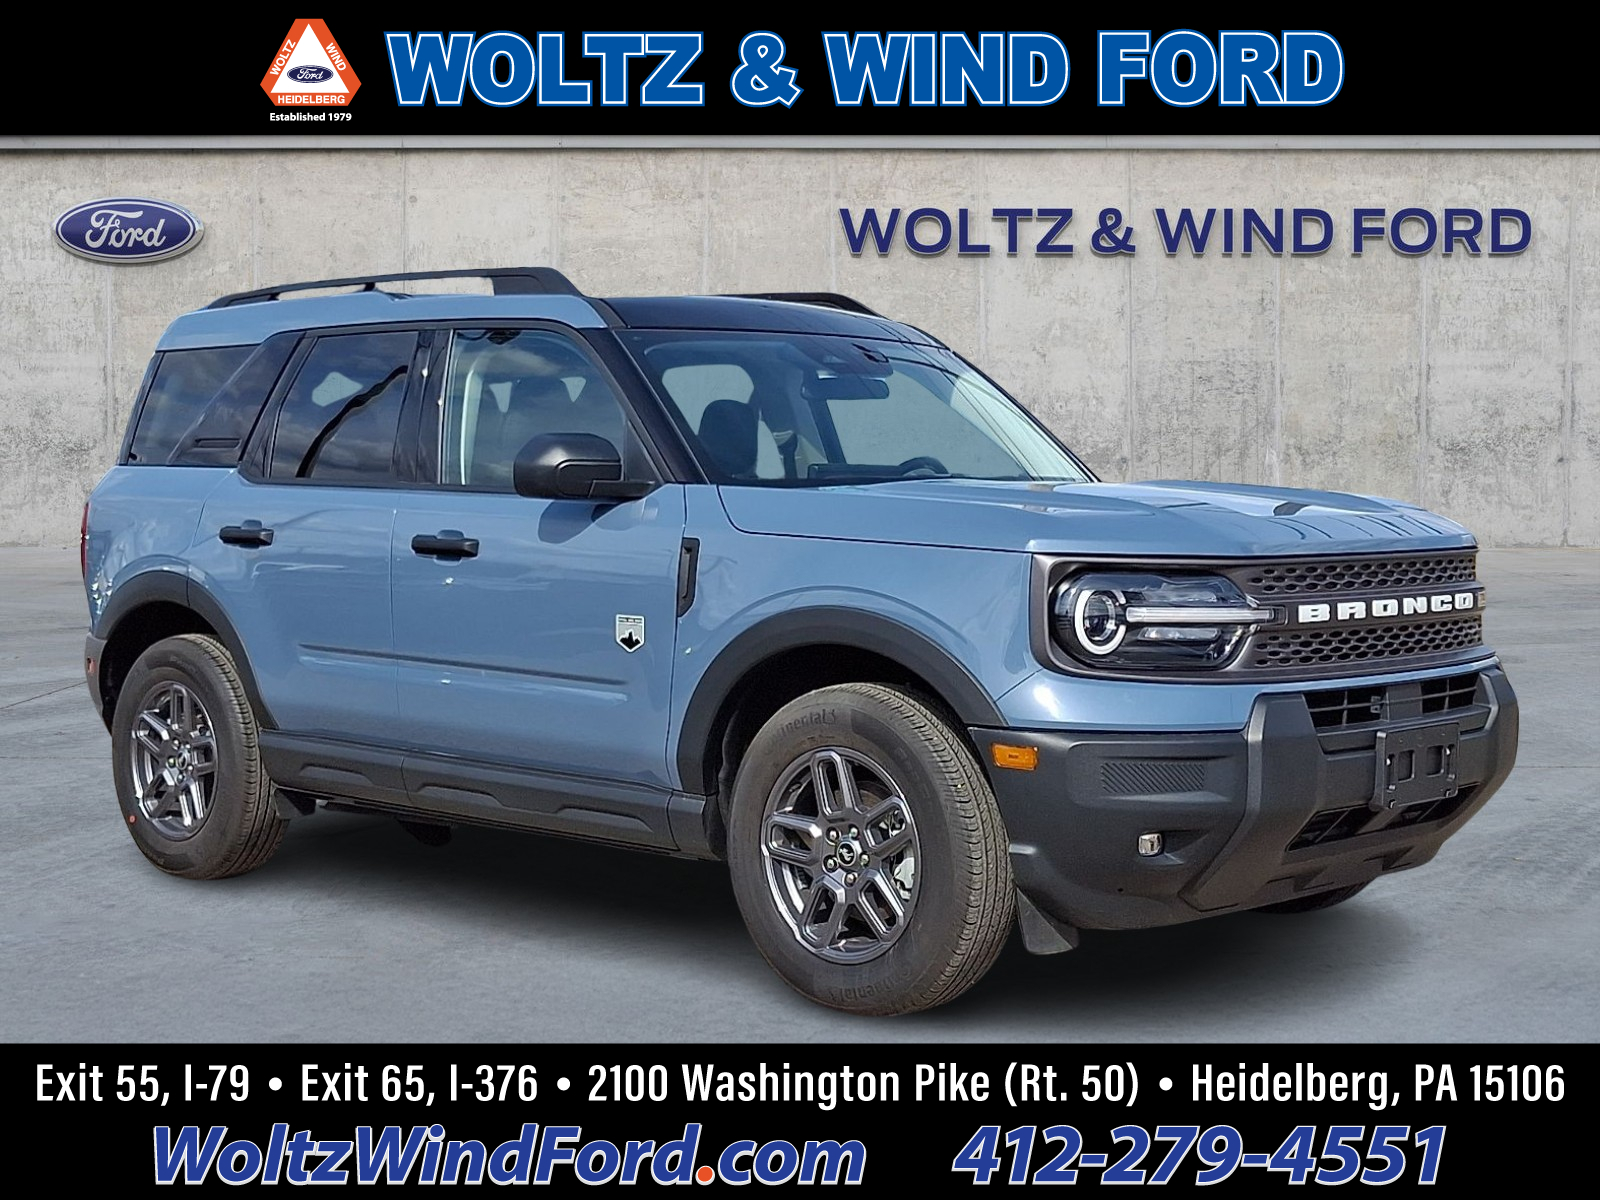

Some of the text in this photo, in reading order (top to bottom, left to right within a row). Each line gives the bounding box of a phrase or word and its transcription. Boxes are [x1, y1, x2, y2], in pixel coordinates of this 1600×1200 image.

[84, 209, 167, 249] Ford
[840, 207, 1532, 255] WOLTZ & WIND FORD
[1297, 592, 1474, 624] BRONCO
